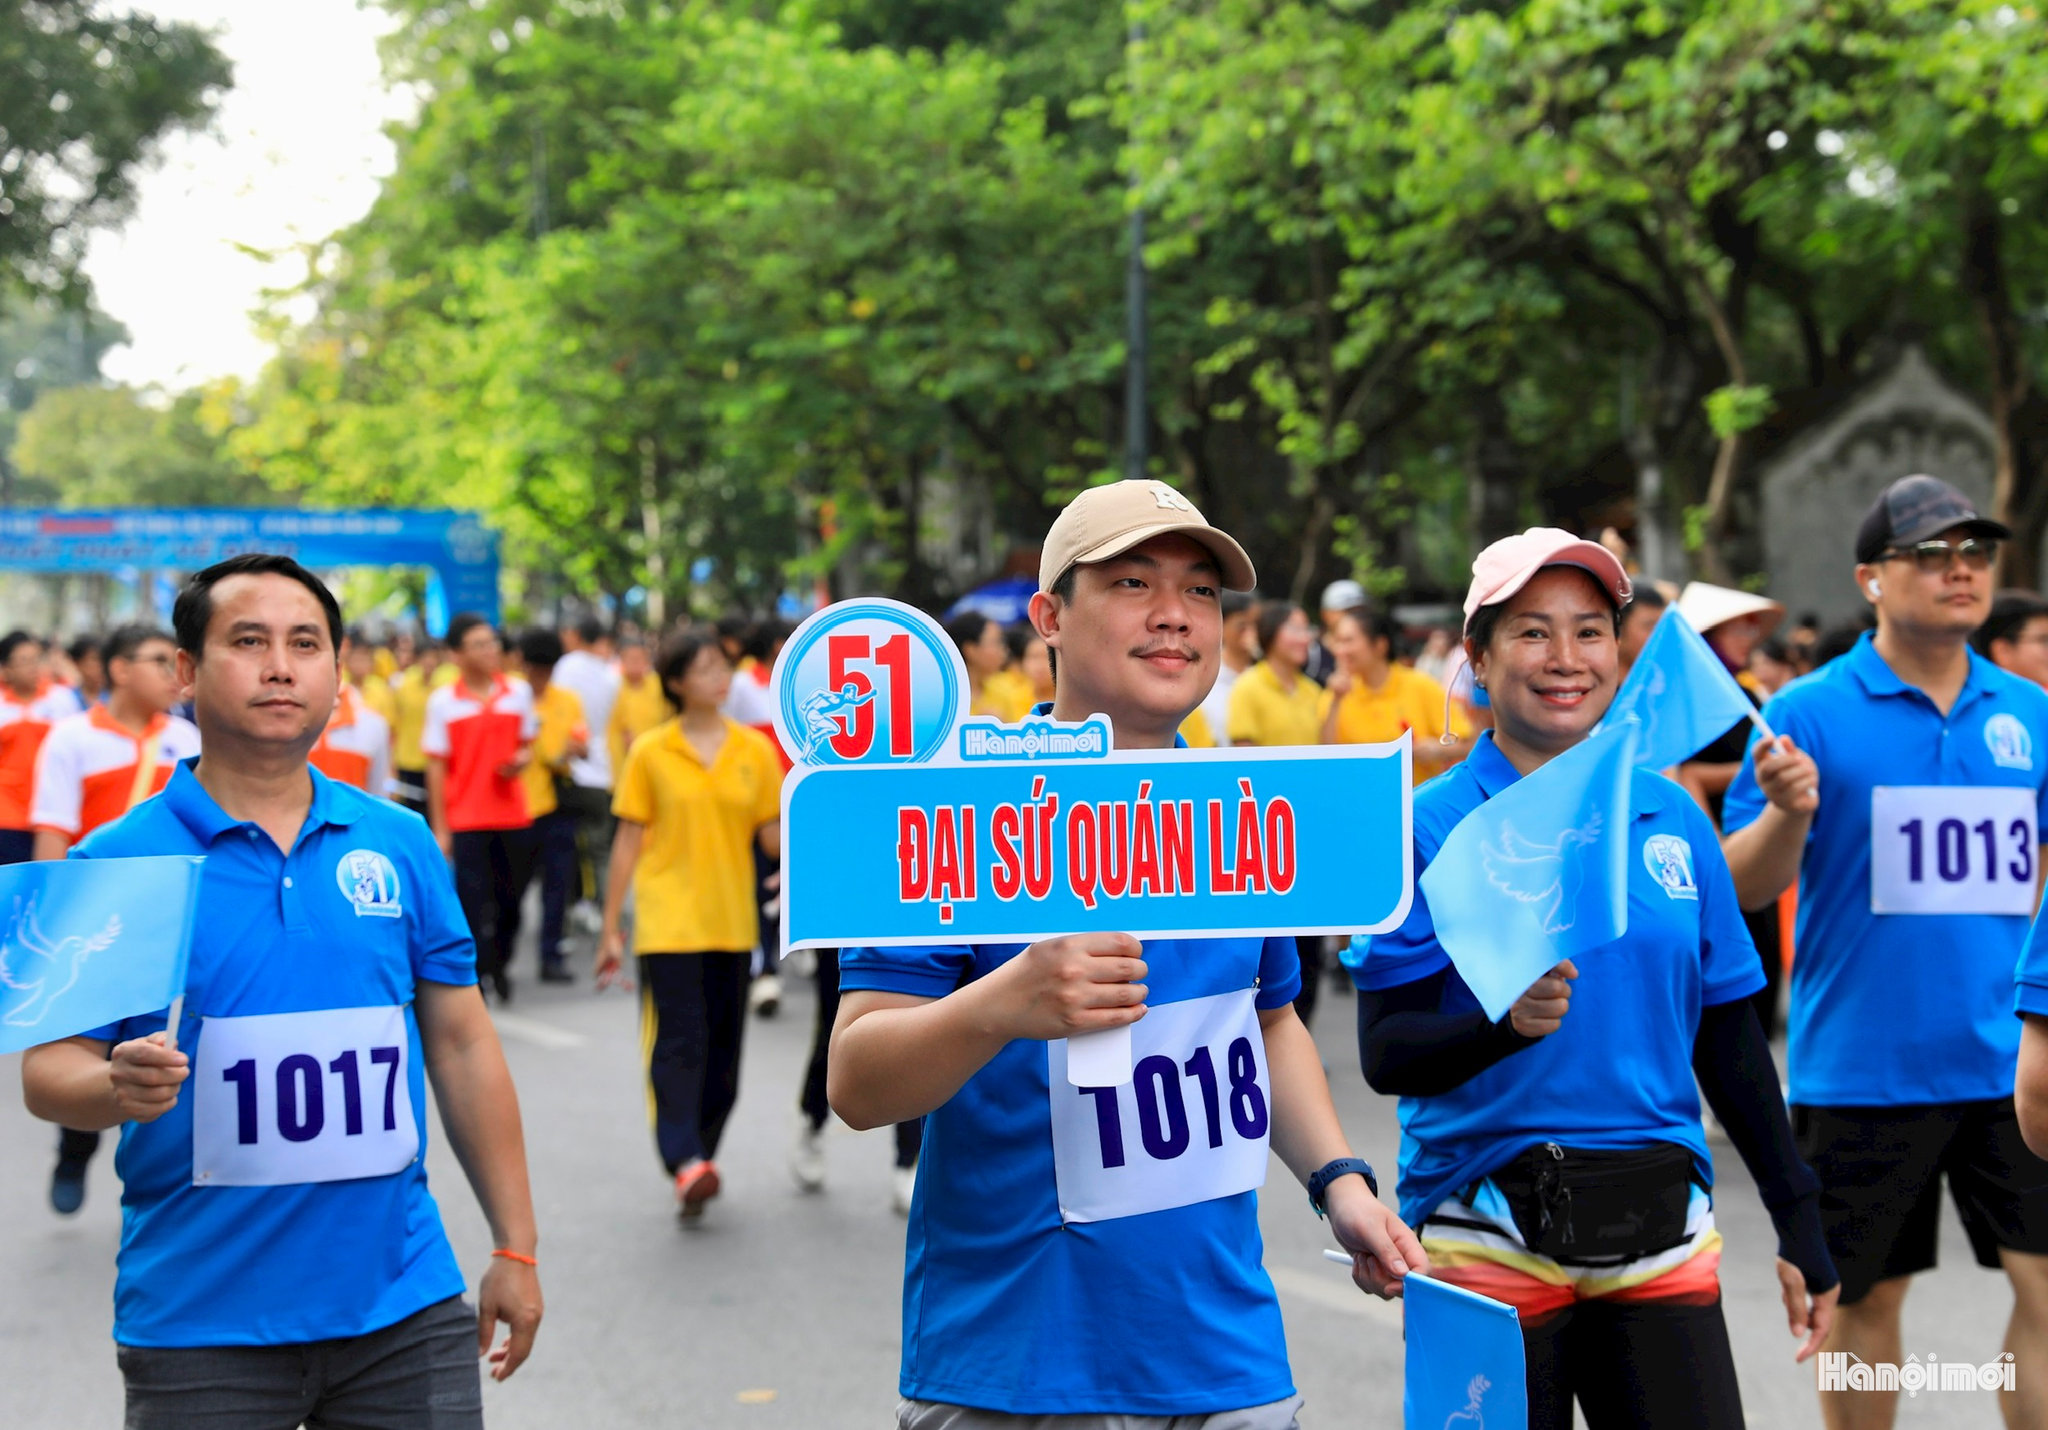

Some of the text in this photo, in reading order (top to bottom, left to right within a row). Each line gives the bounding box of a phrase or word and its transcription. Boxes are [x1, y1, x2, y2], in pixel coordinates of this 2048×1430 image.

[828, 634, 913, 759] 51
[897, 775, 1298, 924] ĐẠI SỨ QUÁN LÀO
[1899, 818, 2032, 884] 1013
[223, 1046, 400, 1145] 1017
[1079, 1036, 1268, 1169] 1018
